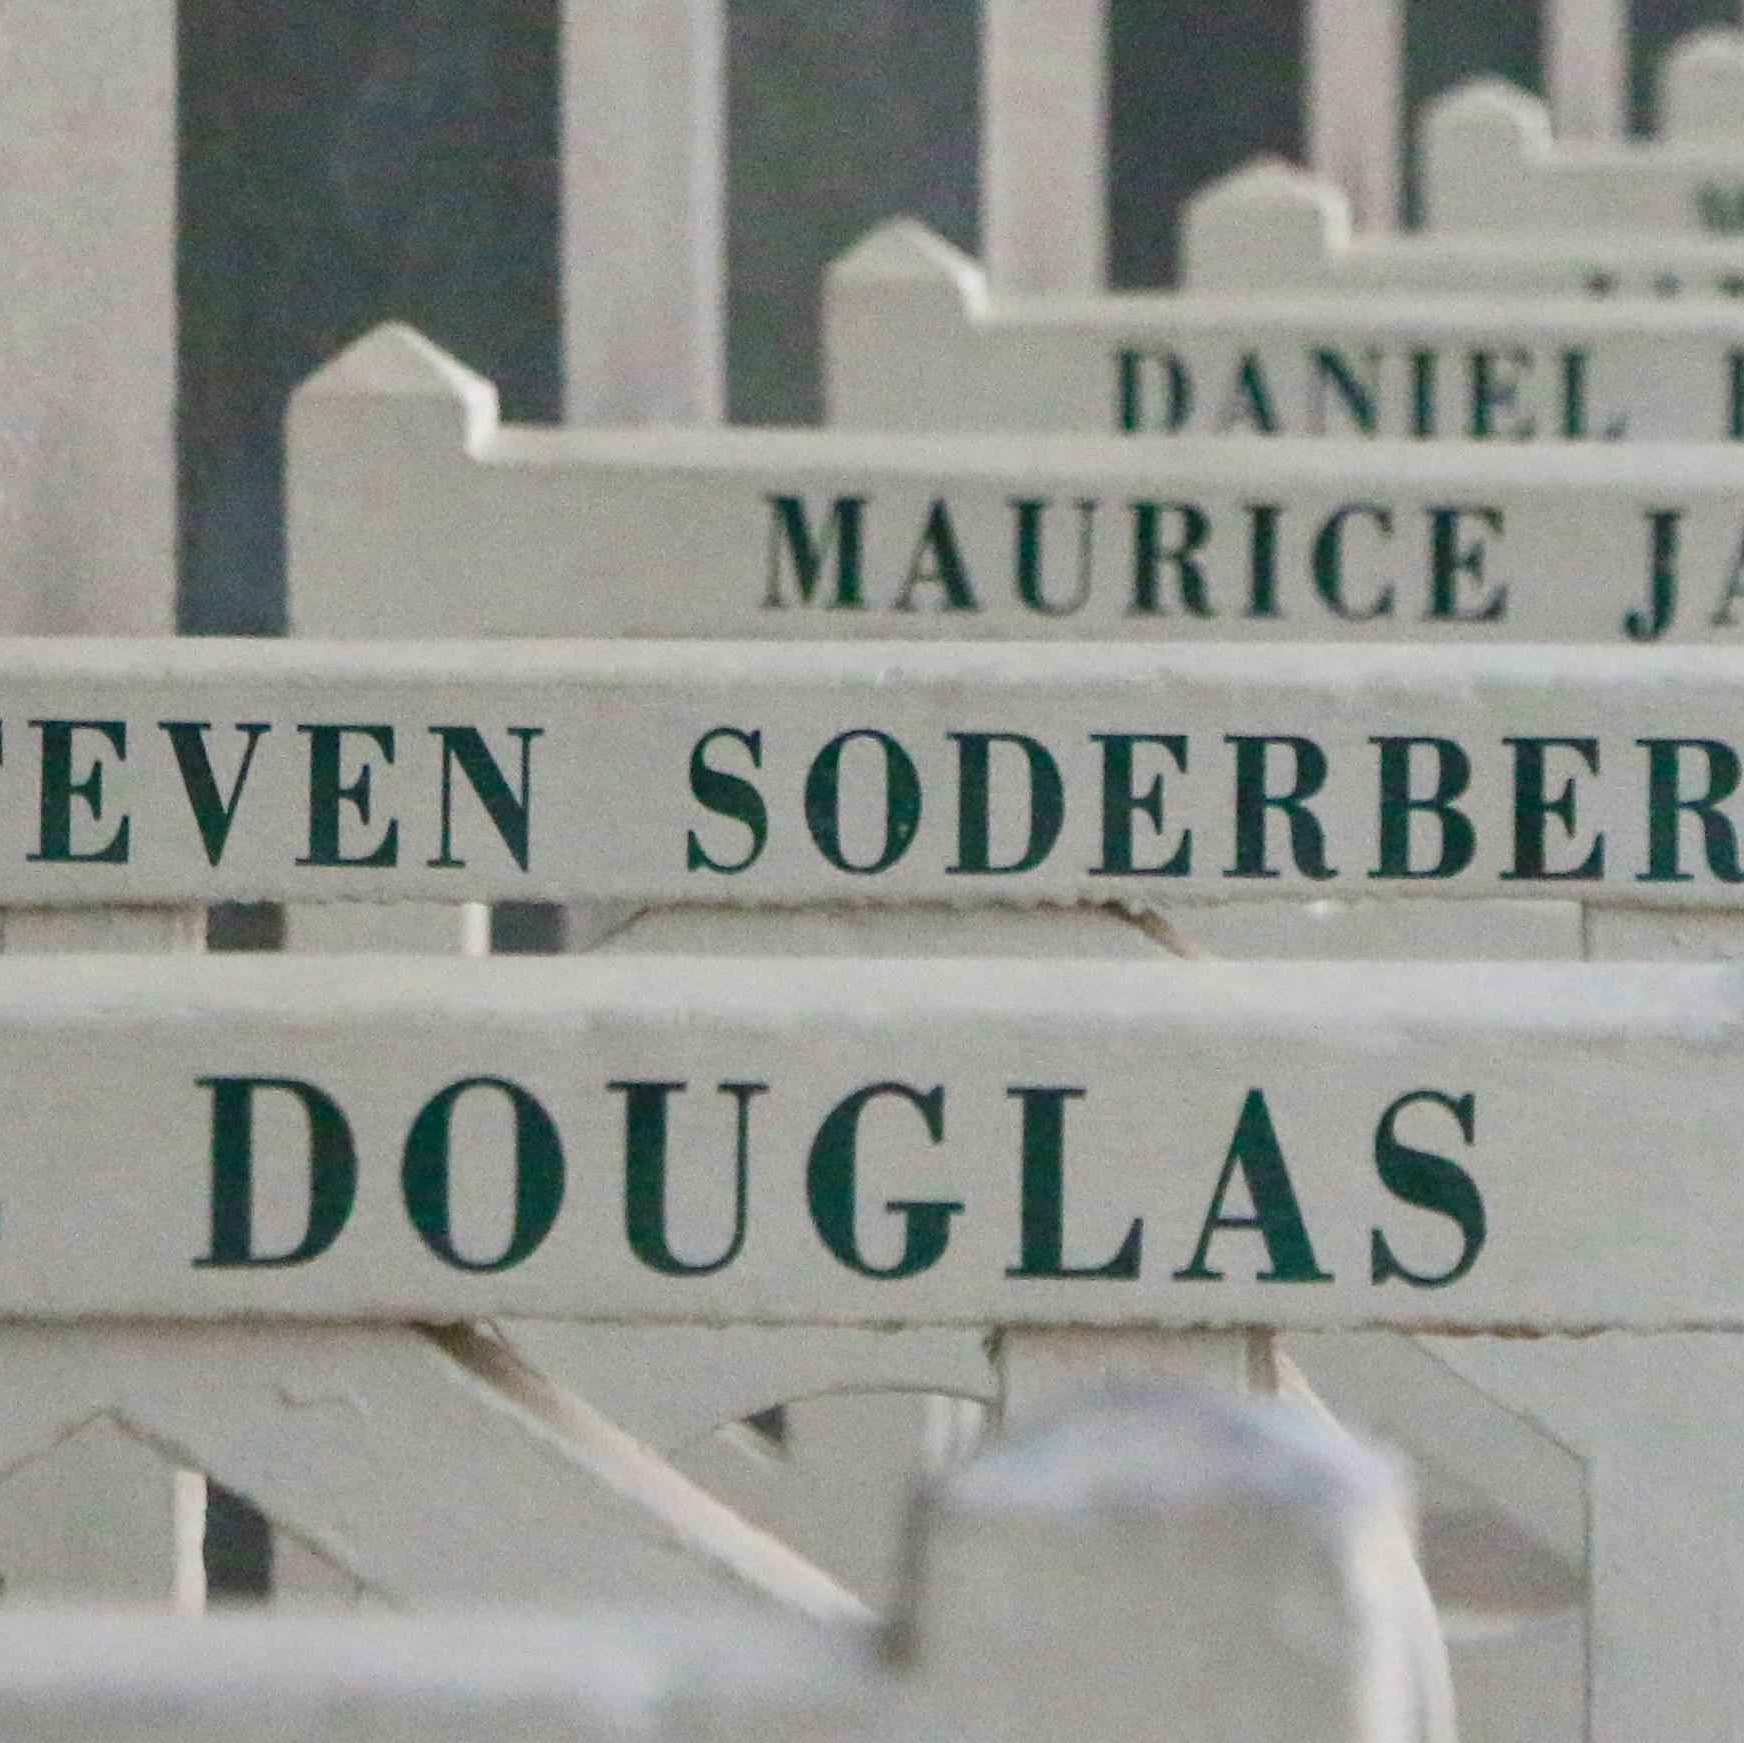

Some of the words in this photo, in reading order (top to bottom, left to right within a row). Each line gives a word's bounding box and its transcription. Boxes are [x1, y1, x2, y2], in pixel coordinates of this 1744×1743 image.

[1112, 344, 1629, 440] DANIEL
[763, 493, 1509, 623] MAURICE
[191, 1074, 1488, 1290] DOUGLAS
